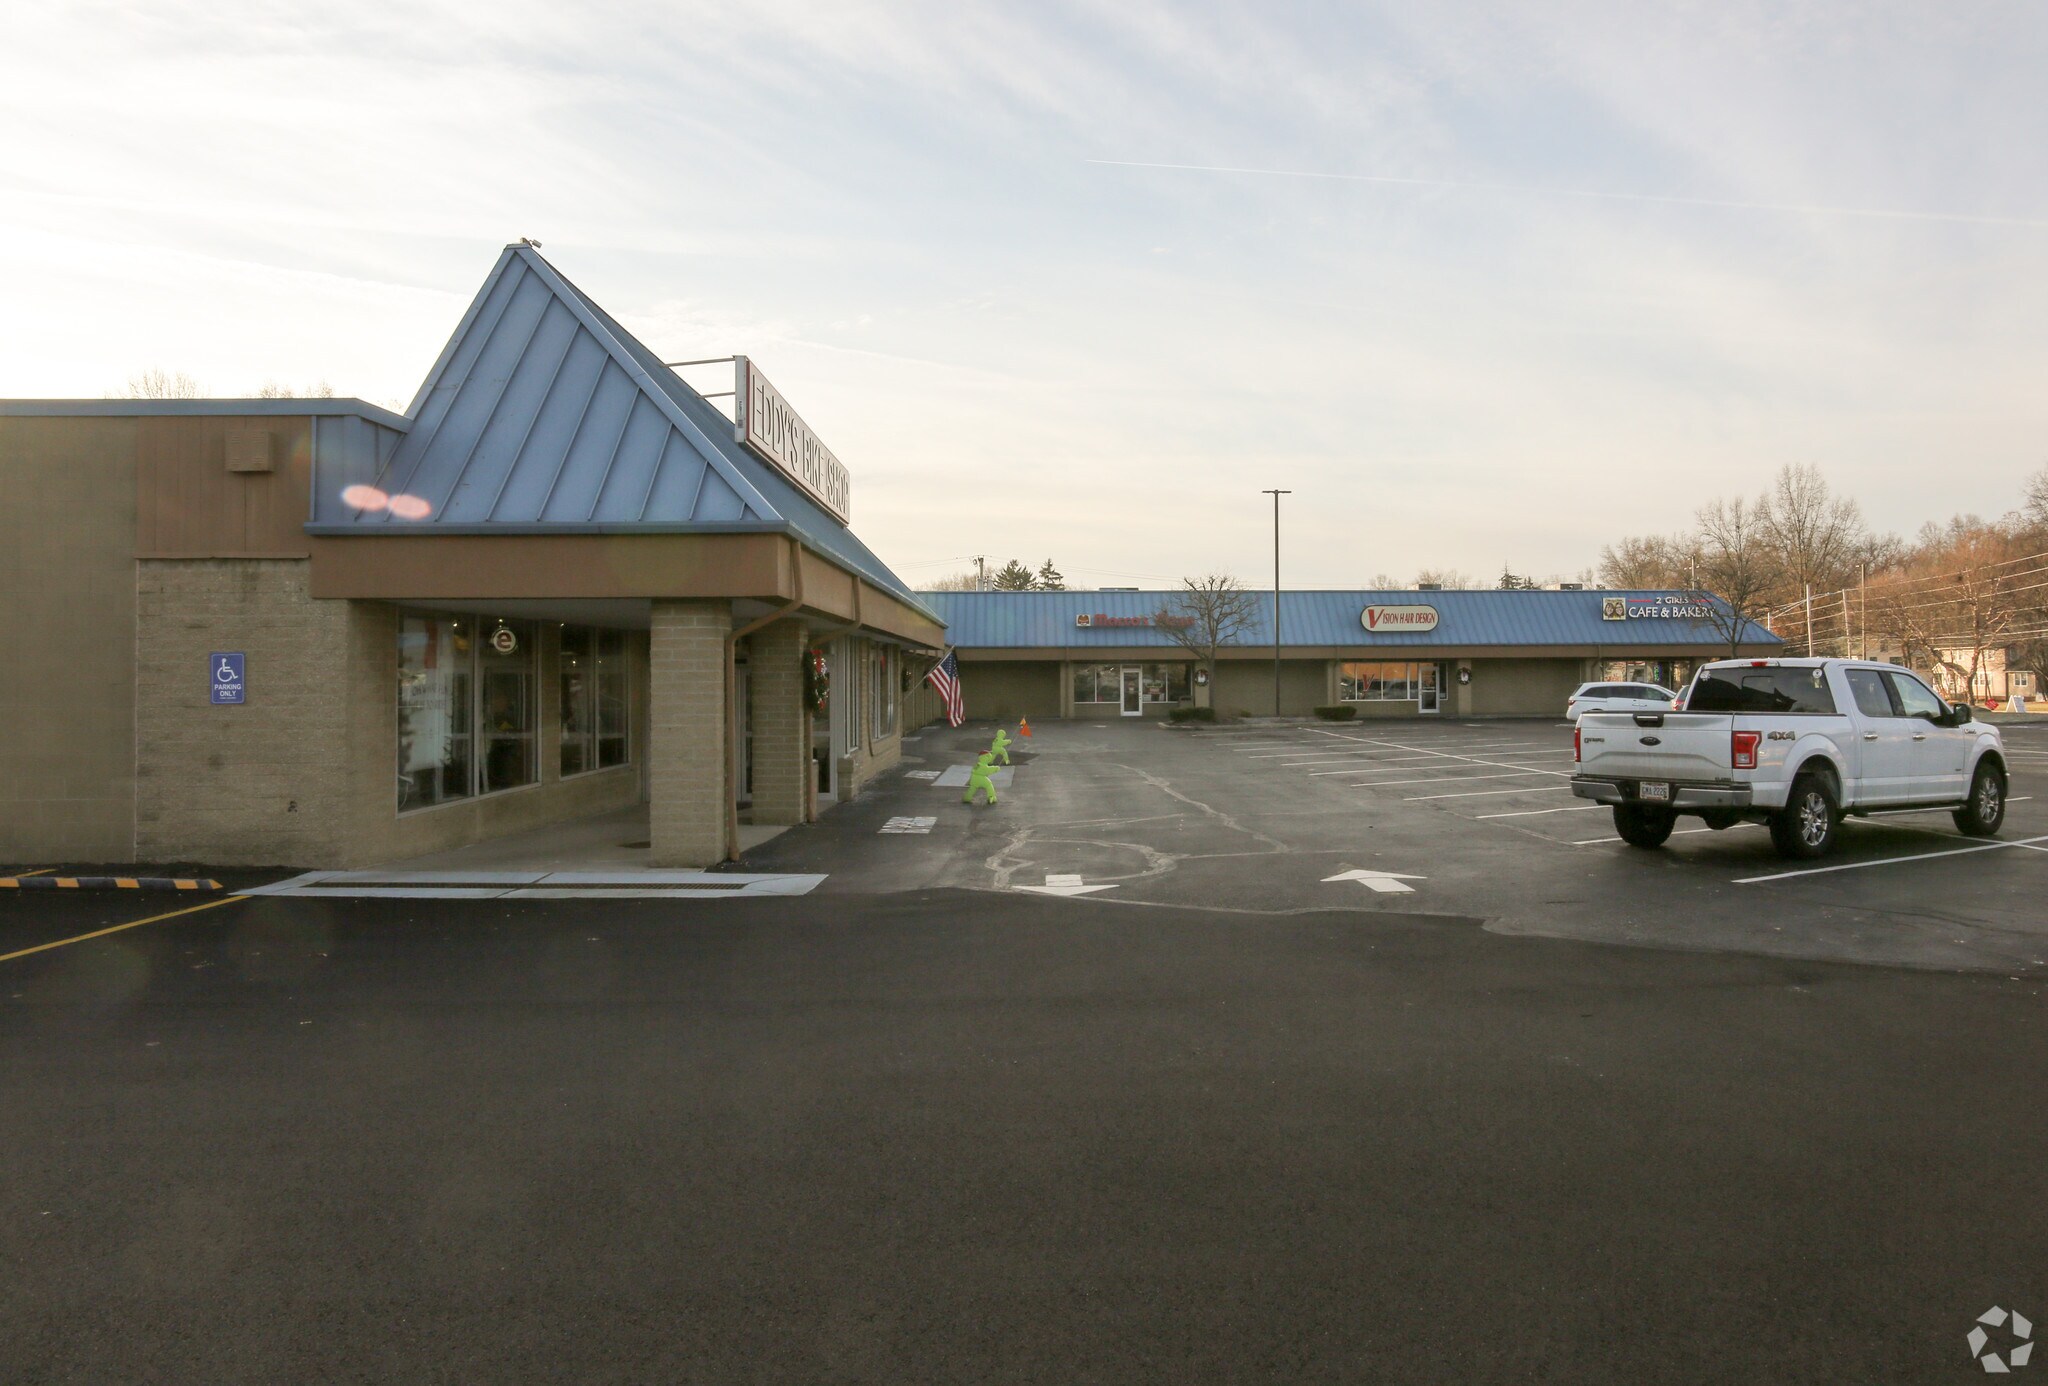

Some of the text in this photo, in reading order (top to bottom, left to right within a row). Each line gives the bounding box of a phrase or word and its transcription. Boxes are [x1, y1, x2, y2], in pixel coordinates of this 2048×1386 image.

[752, 374, 849, 514] EDDY'S BIKE SHOP
[1655, 596, 1689, 604] 2 GIRLS
[1628, 606, 1715, 618] CAFE & BAKERY
[1400, 613, 1415, 624] HAIR
[1415, 613, 1435, 624] DESIGN
